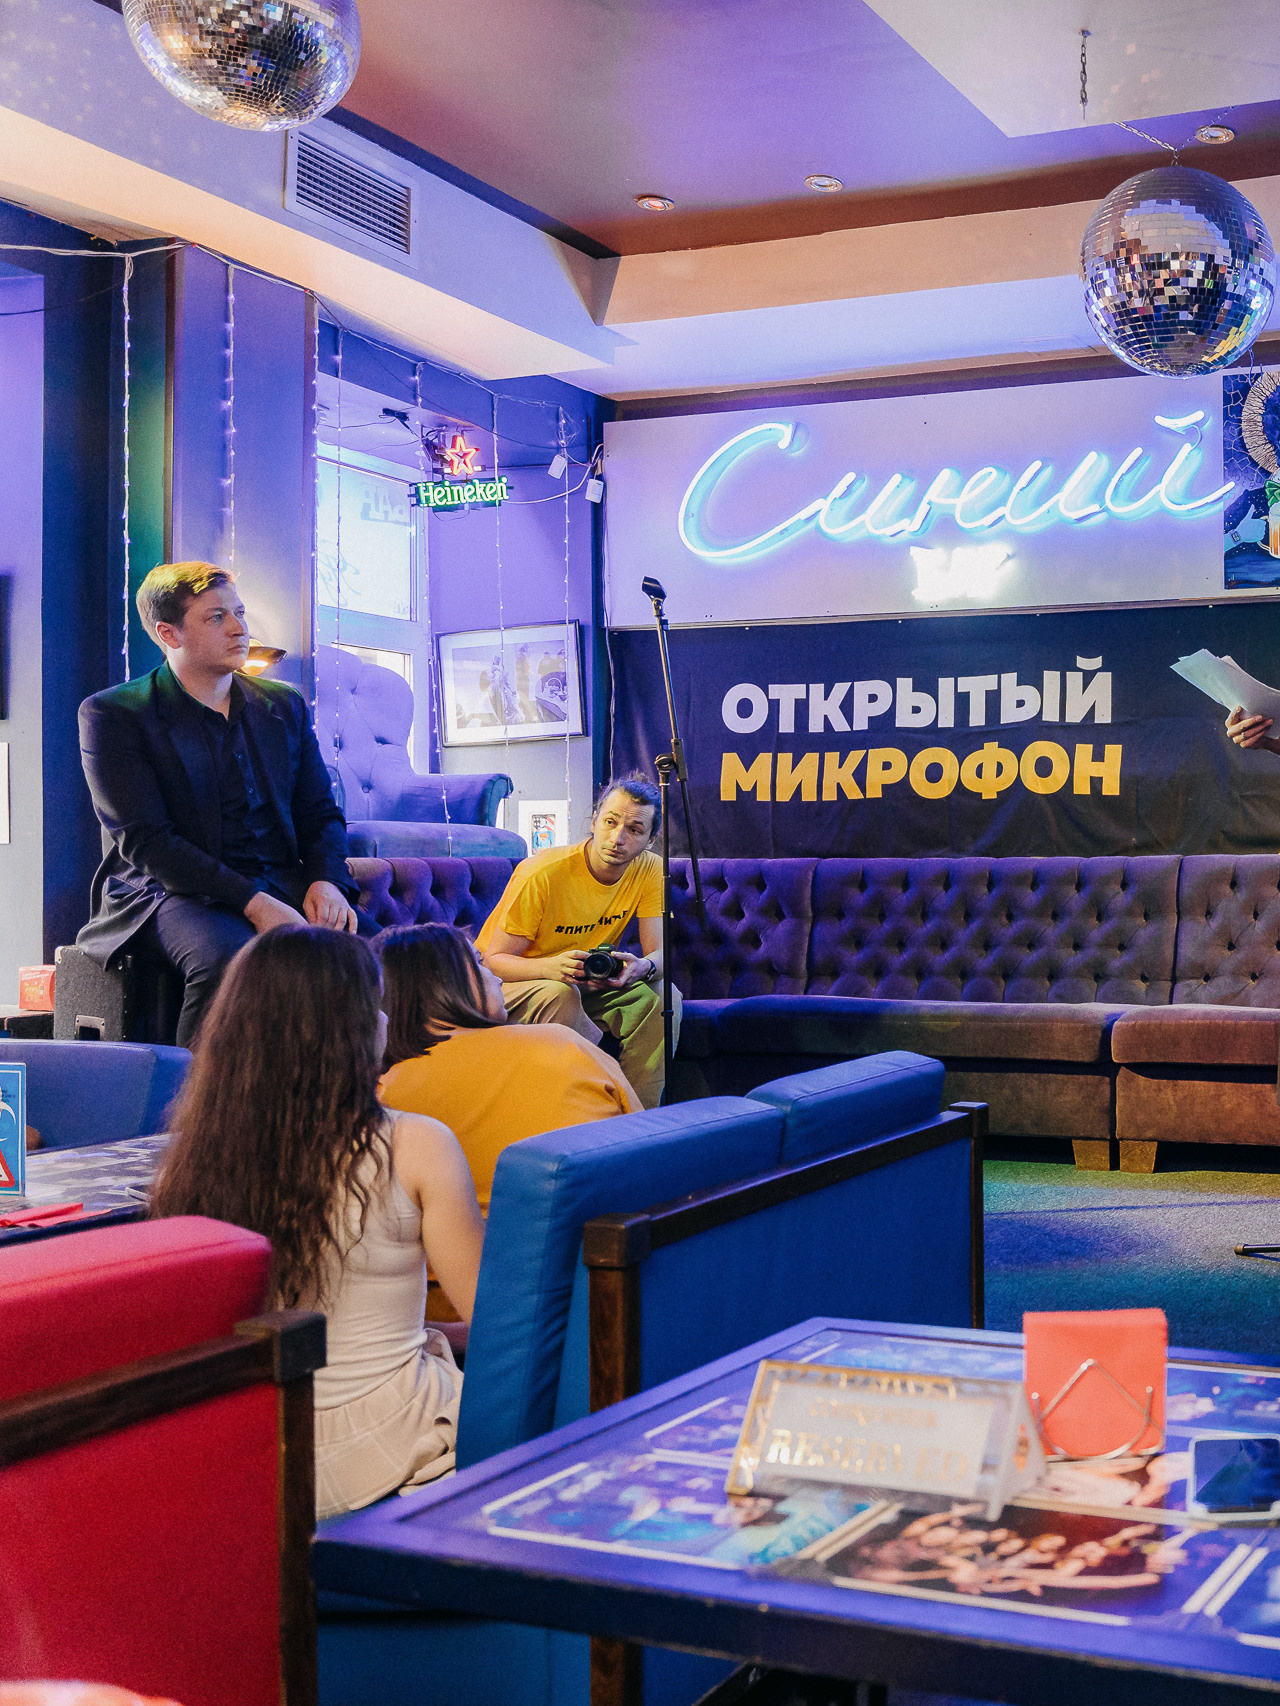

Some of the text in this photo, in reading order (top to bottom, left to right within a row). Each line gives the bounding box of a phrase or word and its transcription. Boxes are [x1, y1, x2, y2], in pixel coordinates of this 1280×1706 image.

[417, 476, 509, 508] Heineken
[678, 410, 1236, 560] Синий
[721, 655, 1112, 734] ОТКРЫТЫЙ
[720, 740, 1122, 802] МИКРОФОН
